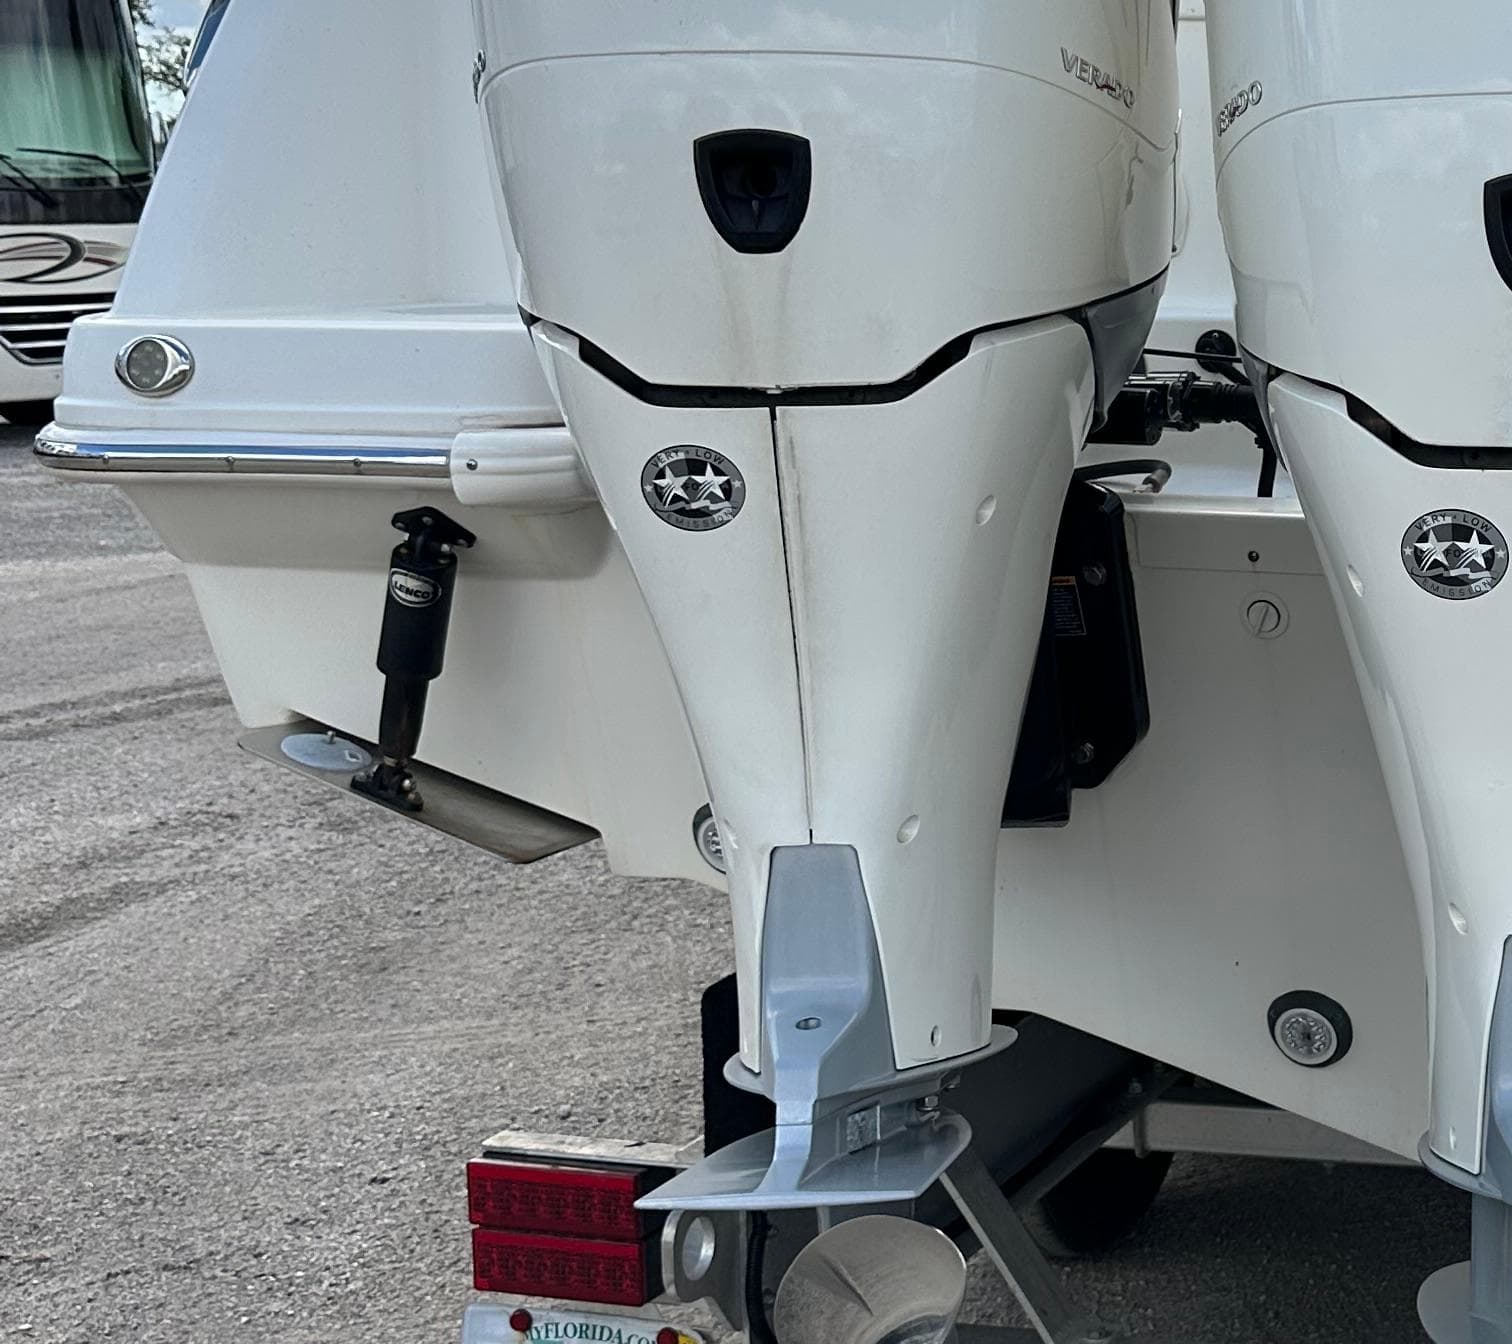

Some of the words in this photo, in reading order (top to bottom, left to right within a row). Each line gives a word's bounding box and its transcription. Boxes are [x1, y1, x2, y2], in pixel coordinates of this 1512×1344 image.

[1061, 47, 1135, 109] VERADO
[651, 448, 681, 469] VERY
[695, 450, 725, 466] LOW
[1414, 513, 1448, 531] VERY
[1463, 513, 1492, 533] LOW
[394, 580, 431, 599] LENCO
